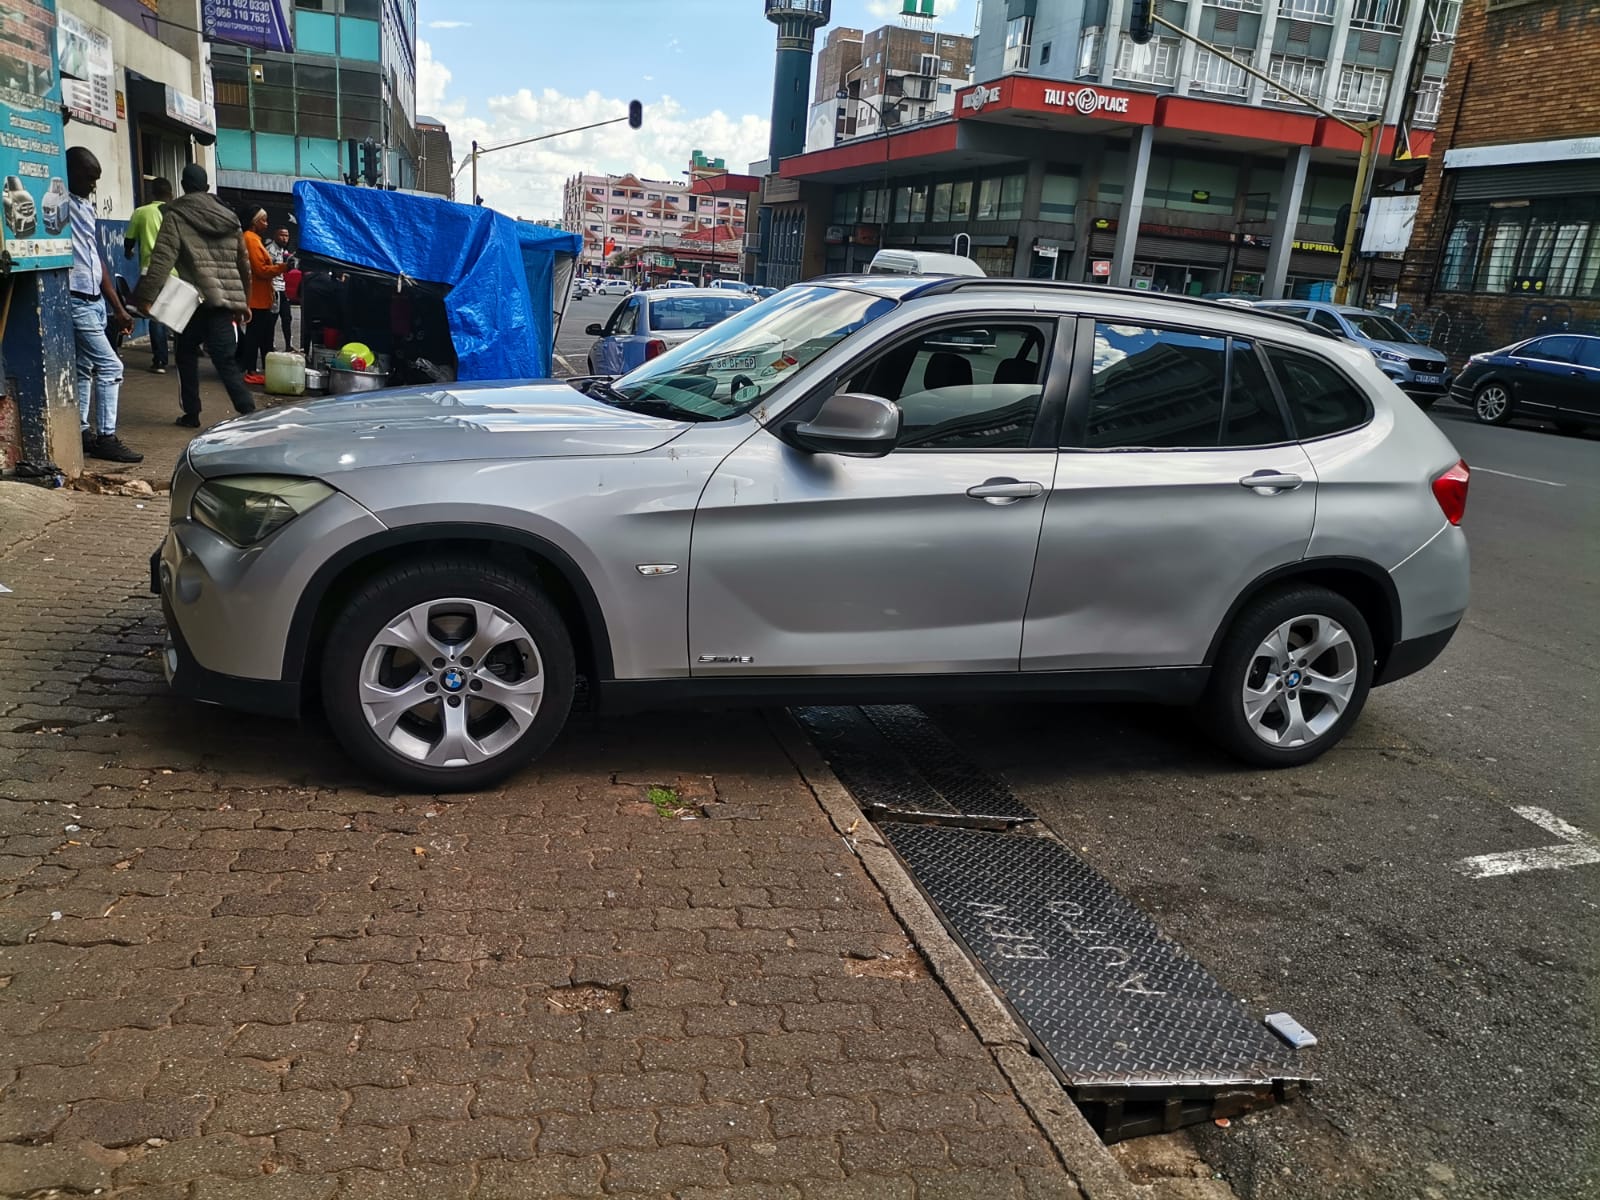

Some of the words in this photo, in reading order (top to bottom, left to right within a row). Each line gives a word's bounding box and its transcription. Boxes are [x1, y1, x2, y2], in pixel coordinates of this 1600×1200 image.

[249, 0, 270, 12] 0330
[235, 9, 248, 21] 110
[1097, 95, 1129, 113] PLACE
[1302, 242, 1345, 253] UPHOLS
